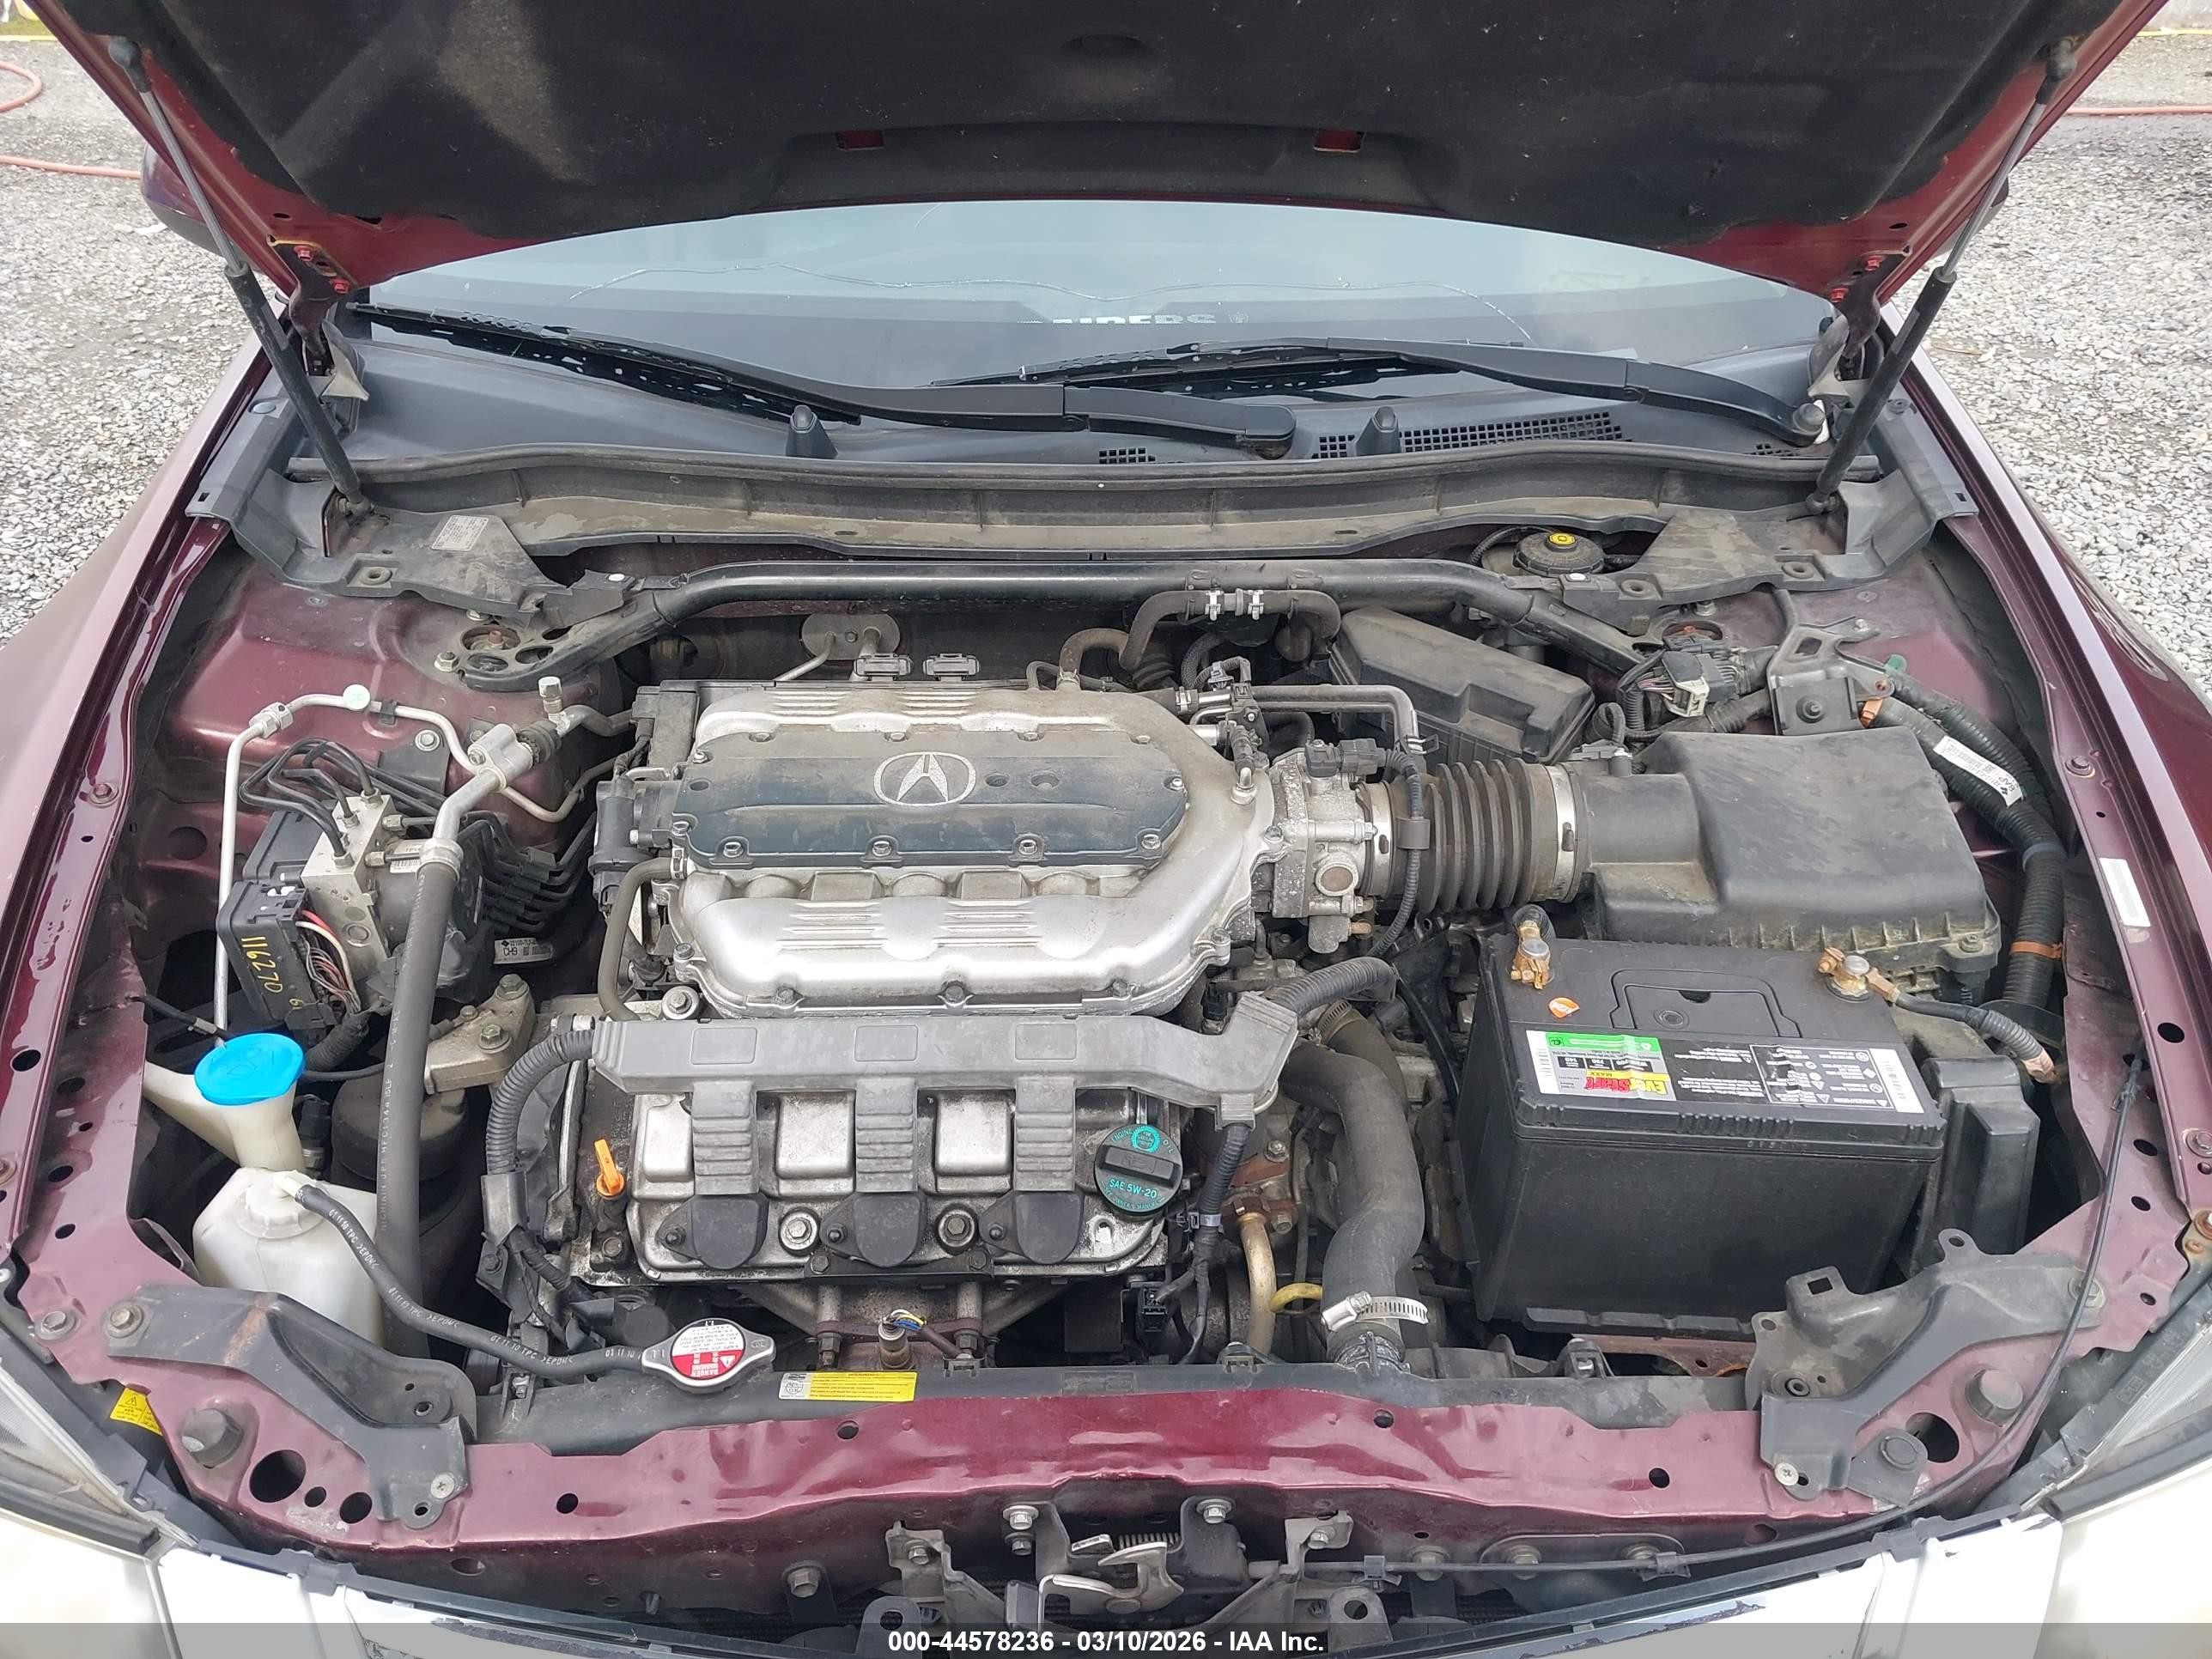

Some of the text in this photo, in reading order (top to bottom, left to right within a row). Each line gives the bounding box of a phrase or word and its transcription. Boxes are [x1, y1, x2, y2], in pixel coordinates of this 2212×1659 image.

[503, 946, 518, 957] CH9
[241, 936, 283, 993] 116270
[1584, 1076, 1668, 1095] EverStart
[1111, 1128, 1133, 1144] ENGINE
[1162, 1139, 1175, 1154] OIL
[1109, 1178, 1158, 1199] SAE 5W-20
